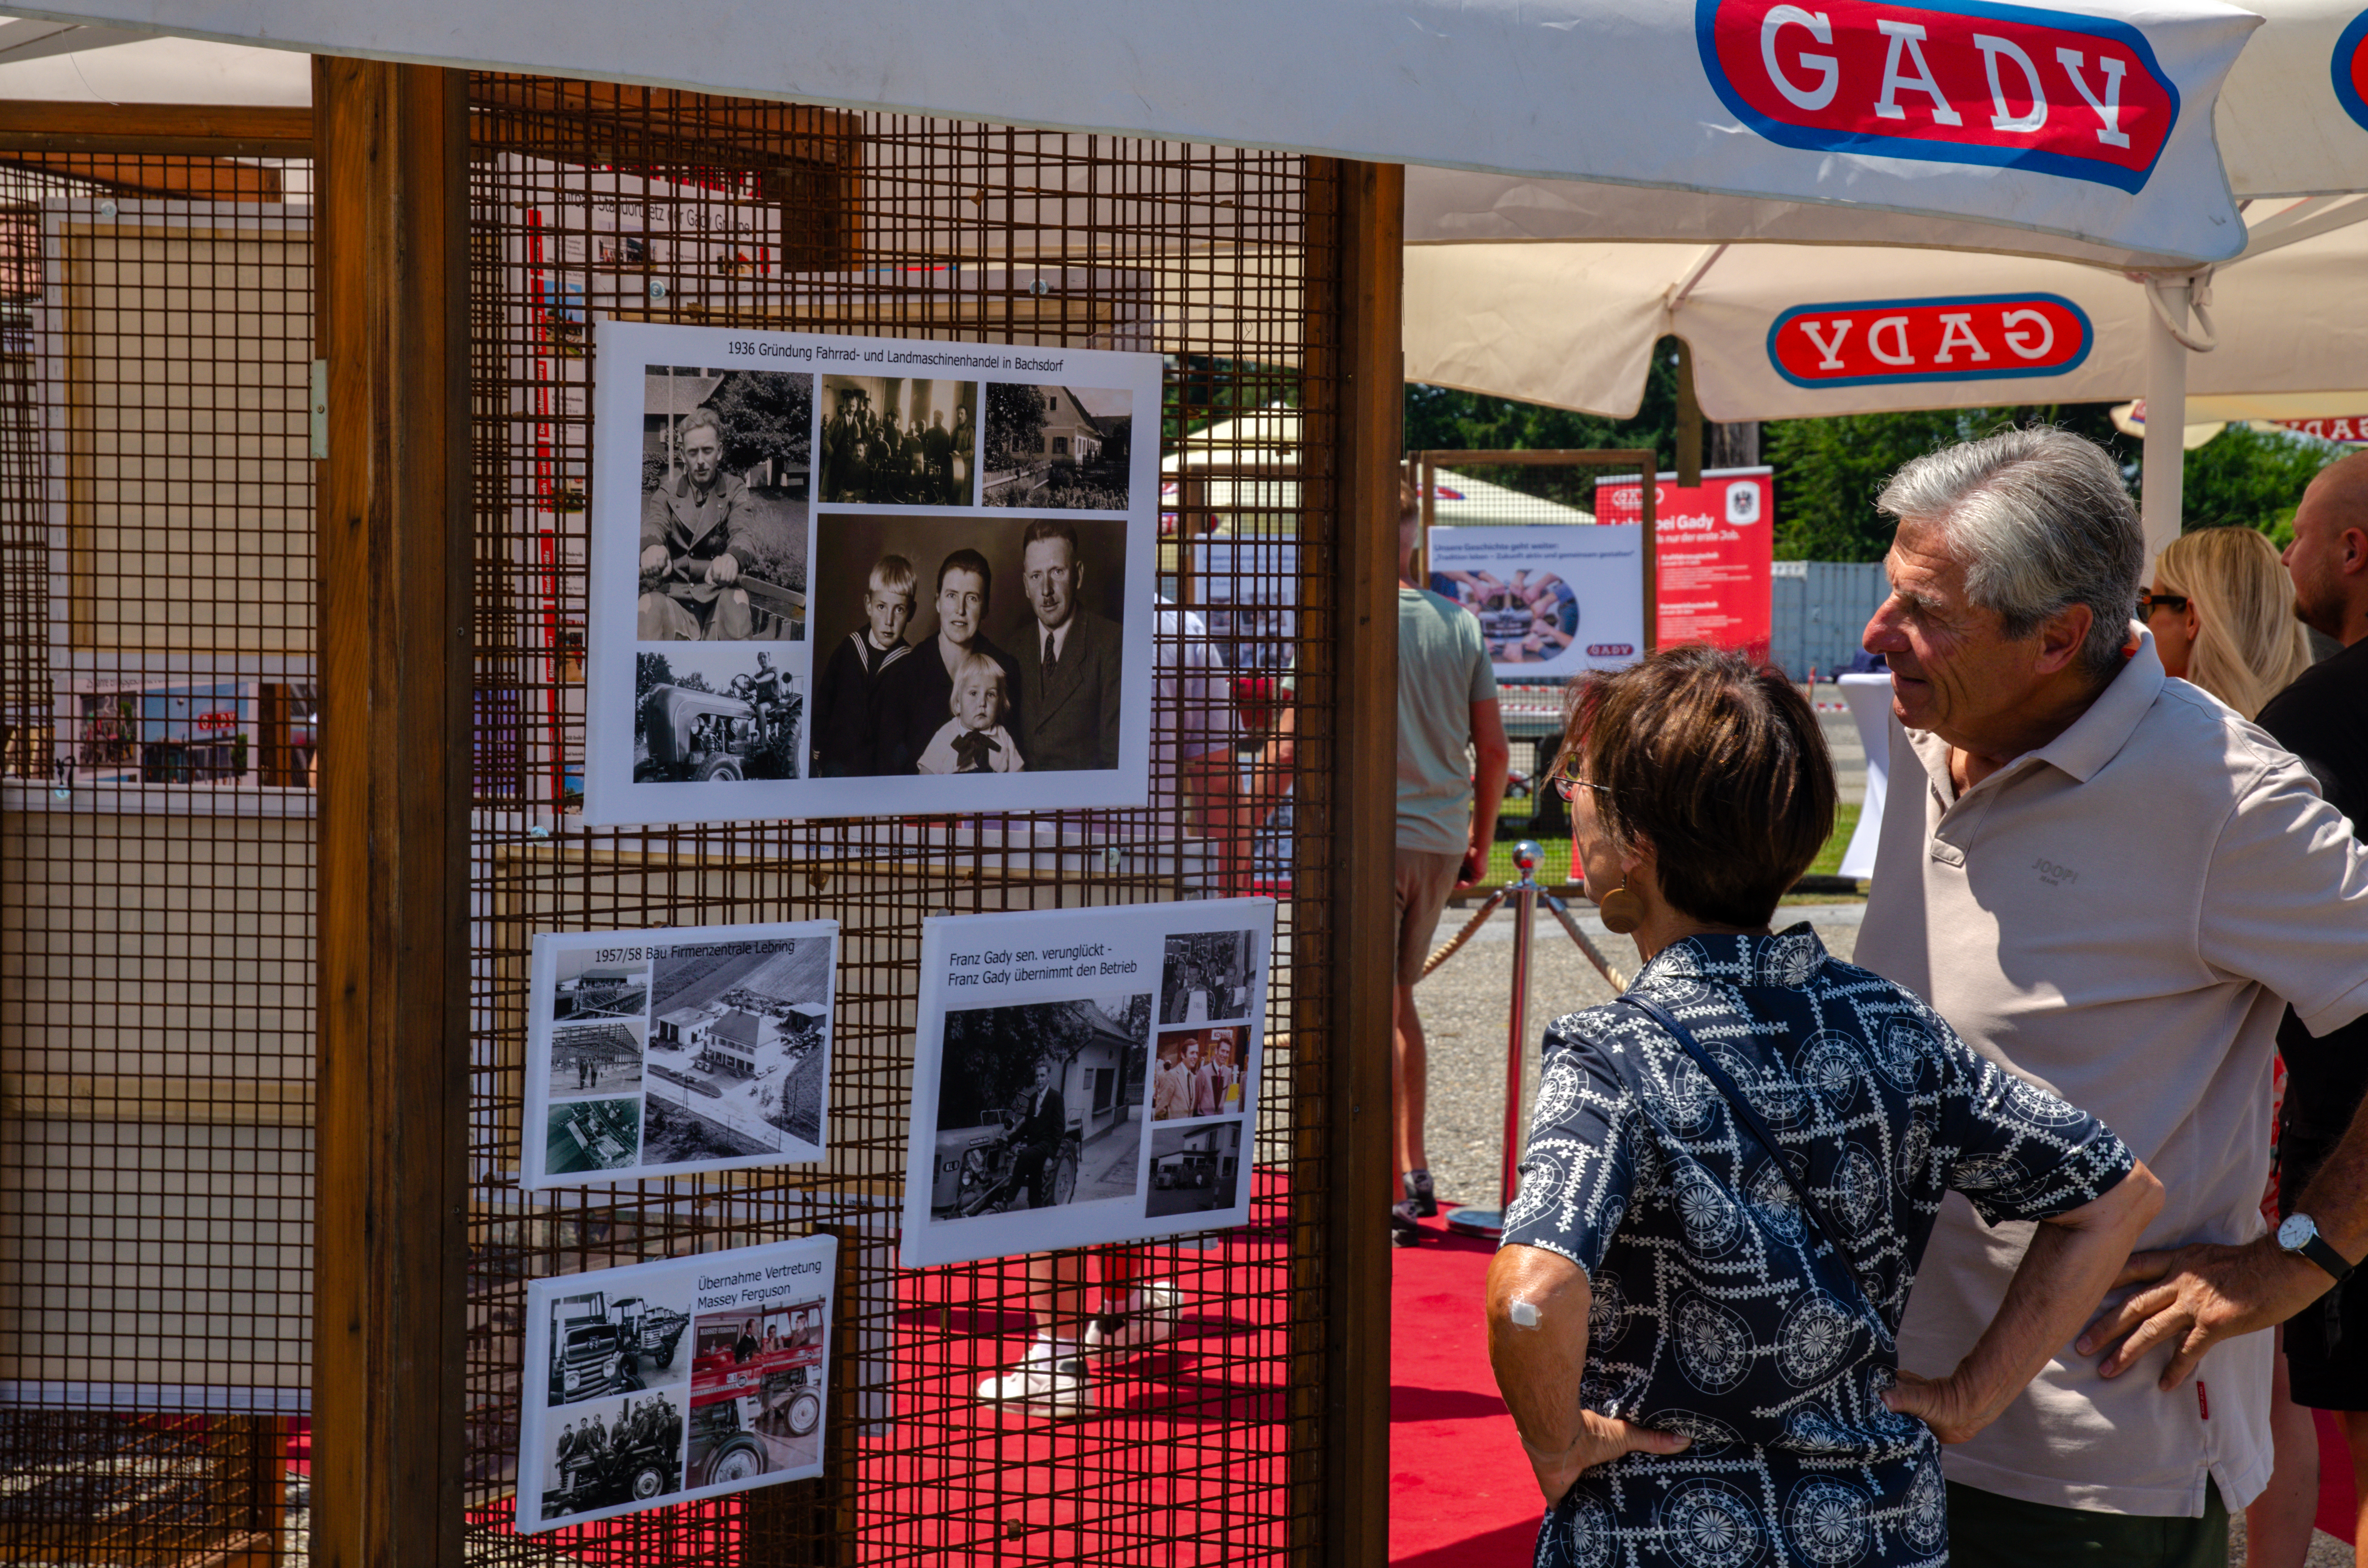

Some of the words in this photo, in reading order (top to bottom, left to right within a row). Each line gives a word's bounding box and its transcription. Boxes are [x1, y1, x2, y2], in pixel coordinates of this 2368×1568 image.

[1760, 4, 2130, 149] GADY
[728, 342, 755, 355] 1936
[759, 343, 812, 361] Gründung
[816, 346, 860, 361] Fahrrad-
[864, 350, 883, 362] und
[888, 350, 999, 368] Landmaschinenhandel
[1003, 356, 1011, 369] in
[1015, 357, 1064, 371] Bachsdorf
[1677, 514, 1714, 531] Gady
[1591, 645, 1629, 655] GADY
[2031, 858, 2079, 884] JOOP!
[596, 948, 641, 963] 1957/58
[646, 947, 666, 959] Bau
[672, 942, 752, 958] Firmenzentrale
[755, 942, 795, 955] Lebring
[950, 953, 980, 966] Franz
[984, 950, 1012, 966] Gady
[1015, 950, 1038, 962] sen.
[1042, 943, 1104, 961] verunglückt
[948, 973, 979, 986] Franz
[983, 969, 1011, 985] Gady
[1015, 964, 1073, 981] übernimmt
[1076, 964, 1096, 977] den
[1100, 960, 1137, 975] Betrieb
[699, 1271, 762, 1291] Übernahme
[765, 1261, 821, 1279] Vertretung
[698, 1293, 738, 1309] Massey
[741, 1284, 790, 1302] Ferguson
